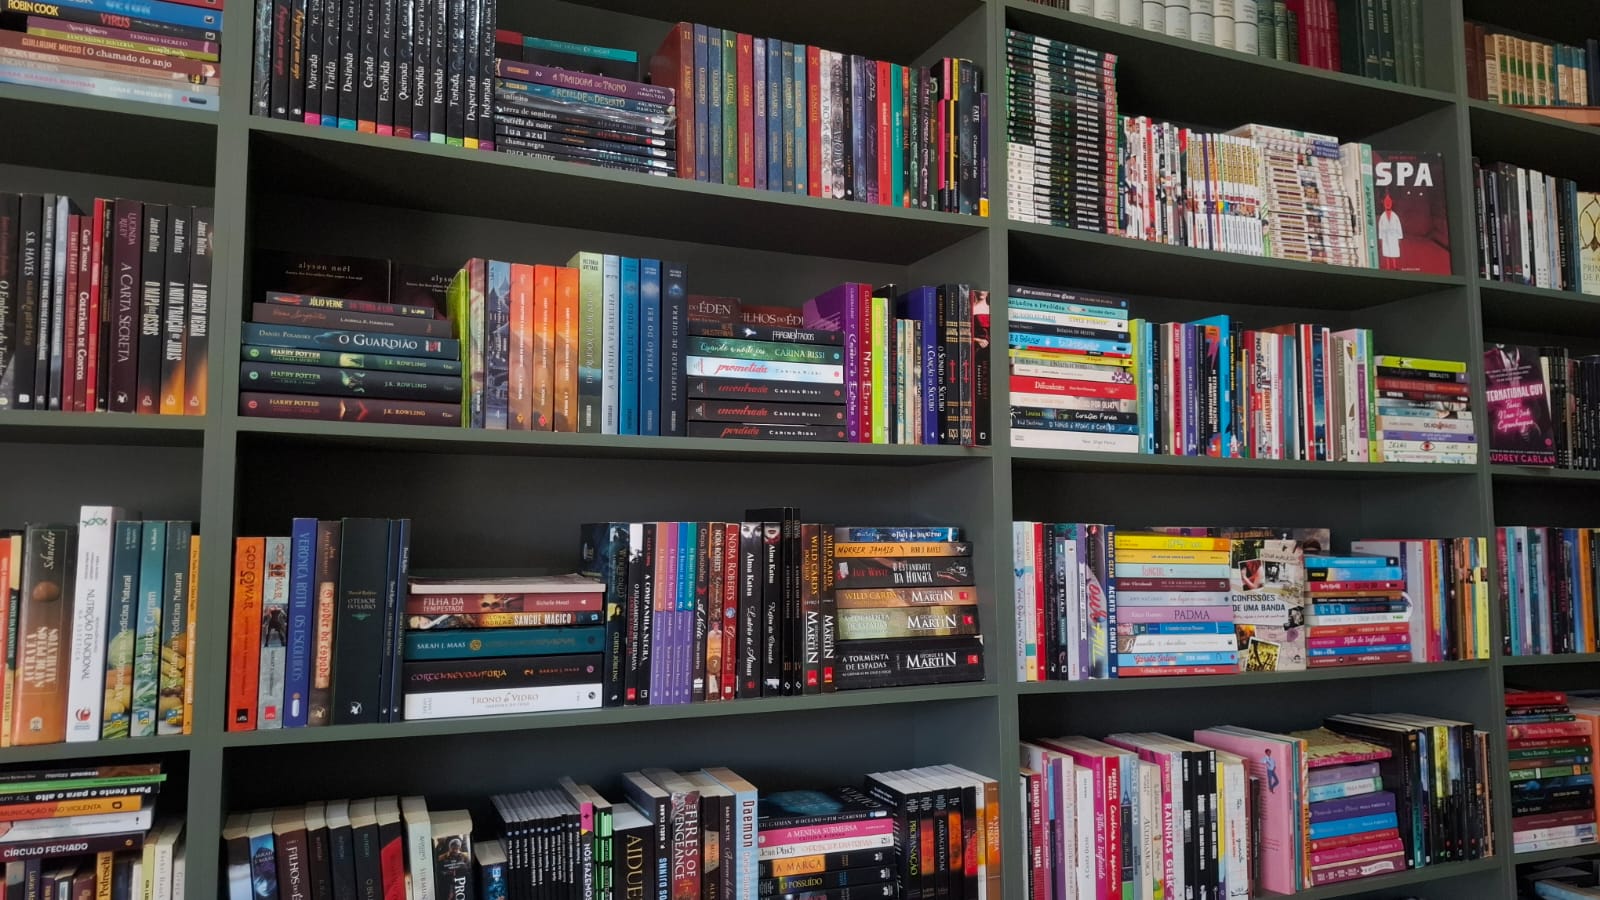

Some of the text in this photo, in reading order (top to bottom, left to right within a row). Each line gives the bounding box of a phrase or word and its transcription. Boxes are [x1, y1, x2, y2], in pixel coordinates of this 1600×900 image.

[8, 0, 33, 13] ROBIN
[34, 3, 59, 16] COOK
[101, 13, 130, 28] VIRUS
[21, 37, 57, 51] GUILLAUME
[58, 42, 81, 54] MUSSO
[95, 49, 173, 69] chamado do anjo
[307, 54, 319, 90] Marcada
[380, 61, 391, 101] Escolhida
[398, 62, 409, 100] Queimada
[415, 66, 426, 107] Escondida
[434, 68, 444, 104] Revelada
[450, 74, 460, 107] Tentada
[559, 73, 627, 93] TRAIDORA TRONO
[466, 76, 478, 120] Despertada
[480, 78, 493, 119] Indomada
[557, 88, 626, 107] REBELDE DESERTO
[503, 106, 558, 120] terra sombras
[505, 126, 547, 140] lua azul
[505, 138, 545, 150] chama negra
[1375, 162, 1434, 187] SPA
[127, 212, 137, 245] LUCINDA
[149, 217, 160, 233] James
[24, 247, 35, 276] HAYES
[117, 263, 134, 362] A CARTA SECRETA
[142, 287, 160, 336] MAPA OSSOS
[309, 297, 344, 309] JÚLIO VERNE
[698, 301, 732, 315] ÉDEN
[190, 289, 208, 337] ORDEM NEGRA
[608, 293, 616, 342] VERMELHA
[671, 304, 679, 336] GUERRA
[166, 288, 186, 361] NOVA TRAIÇÃO JUDAS
[76, 291, 90, 380] COLETÂNEA CONTOS
[339, 333, 418, 350] O GUARDIÃO
[645, 307, 655, 373] PRISÃO DO REI
[1255, 338, 1262, 351] NO
[270, 349, 321, 359] HARRY POTTER
[775, 349, 825, 359] CARINA RISSI
[396, 360, 427, 369] ROWLING
[715, 361, 769, 377] prometida
[270, 370, 321, 380] HARRY POTTER
[925, 351, 937, 412] CANÇÃO SÚCUBO
[937, 352, 947, 412] SONHO SÚCUBO
[1529, 383, 1543, 395] GUY
[717, 405, 769, 417] encontrada
[720, 426, 760, 438] perdida
[1520, 454, 1556, 463] CARLAN
[39, 530, 56, 570] Schneider
[726, 533, 737, 600] NORA ROBERTS
[768, 544, 776, 584] Alma Katsu
[810, 536, 819, 595] WILD CARDS
[243, 546, 257, 610] GOD WAR
[746, 552, 755, 597] Alma Katsu
[895, 572, 933, 584] DA HONRA
[169, 572, 183, 639] Medicina Natural
[424, 597, 464, 607] FILHA DA
[911, 589, 954, 603] MARTIN
[1231, 594, 1275, 602] CONFISSÕES
[118, 575, 132, 637] Medicina Natural
[292, 532, 311, 681] VERONICA ROTH ESCOLHIDOS
[632, 589, 640, 631] JULGAMENTO
[1174, 610, 1210, 620] PADMA
[1261, 604, 1286, 612] BANDA
[514, 613, 572, 626] SANGUE MÁGICO
[907, 613, 957, 629] MARTIN
[1110, 615, 1116, 624] DE
[81, 589, 96, 680] NUTRIÇÃO FUNCIONAL
[141, 591, 156, 675] As Plantas Curam
[318, 602, 333, 679] poder espada
[806, 610, 819, 664] MARTIN
[641, 635, 649, 661] NEGRA
[850, 653, 890, 662] TORMENTA
[746, 647, 757, 676] Almas
[857, 662, 887, 670] ESPADAS
[906, 651, 957, 669] MARTIN
[472, 693, 539, 705] TRONO VIDRO
[35, 792, 55, 801] alto
[66, 790, 88, 798] para
[104, 787, 132, 797] frente
[66, 803, 102, 813] VIOLENTA
[842, 812, 867, 820] CAMINHO
[742, 800, 755, 848] Daemon
[793, 825, 857, 838] MENINA SUBMERSA
[4, 843, 88, 857] CÍRCULO FECHADO
[583, 843, 594, 860] NÓS
[675, 806, 686, 880] VENGEANCE
[685, 811, 698, 877] FIRES OF
[910, 820, 918, 876] PROFANAÇÃO
[1165, 803, 1173, 888] RAINHAS GEEK
[786, 860, 822, 869] MARCA
[788, 878, 822, 889] POSSUÍDO
